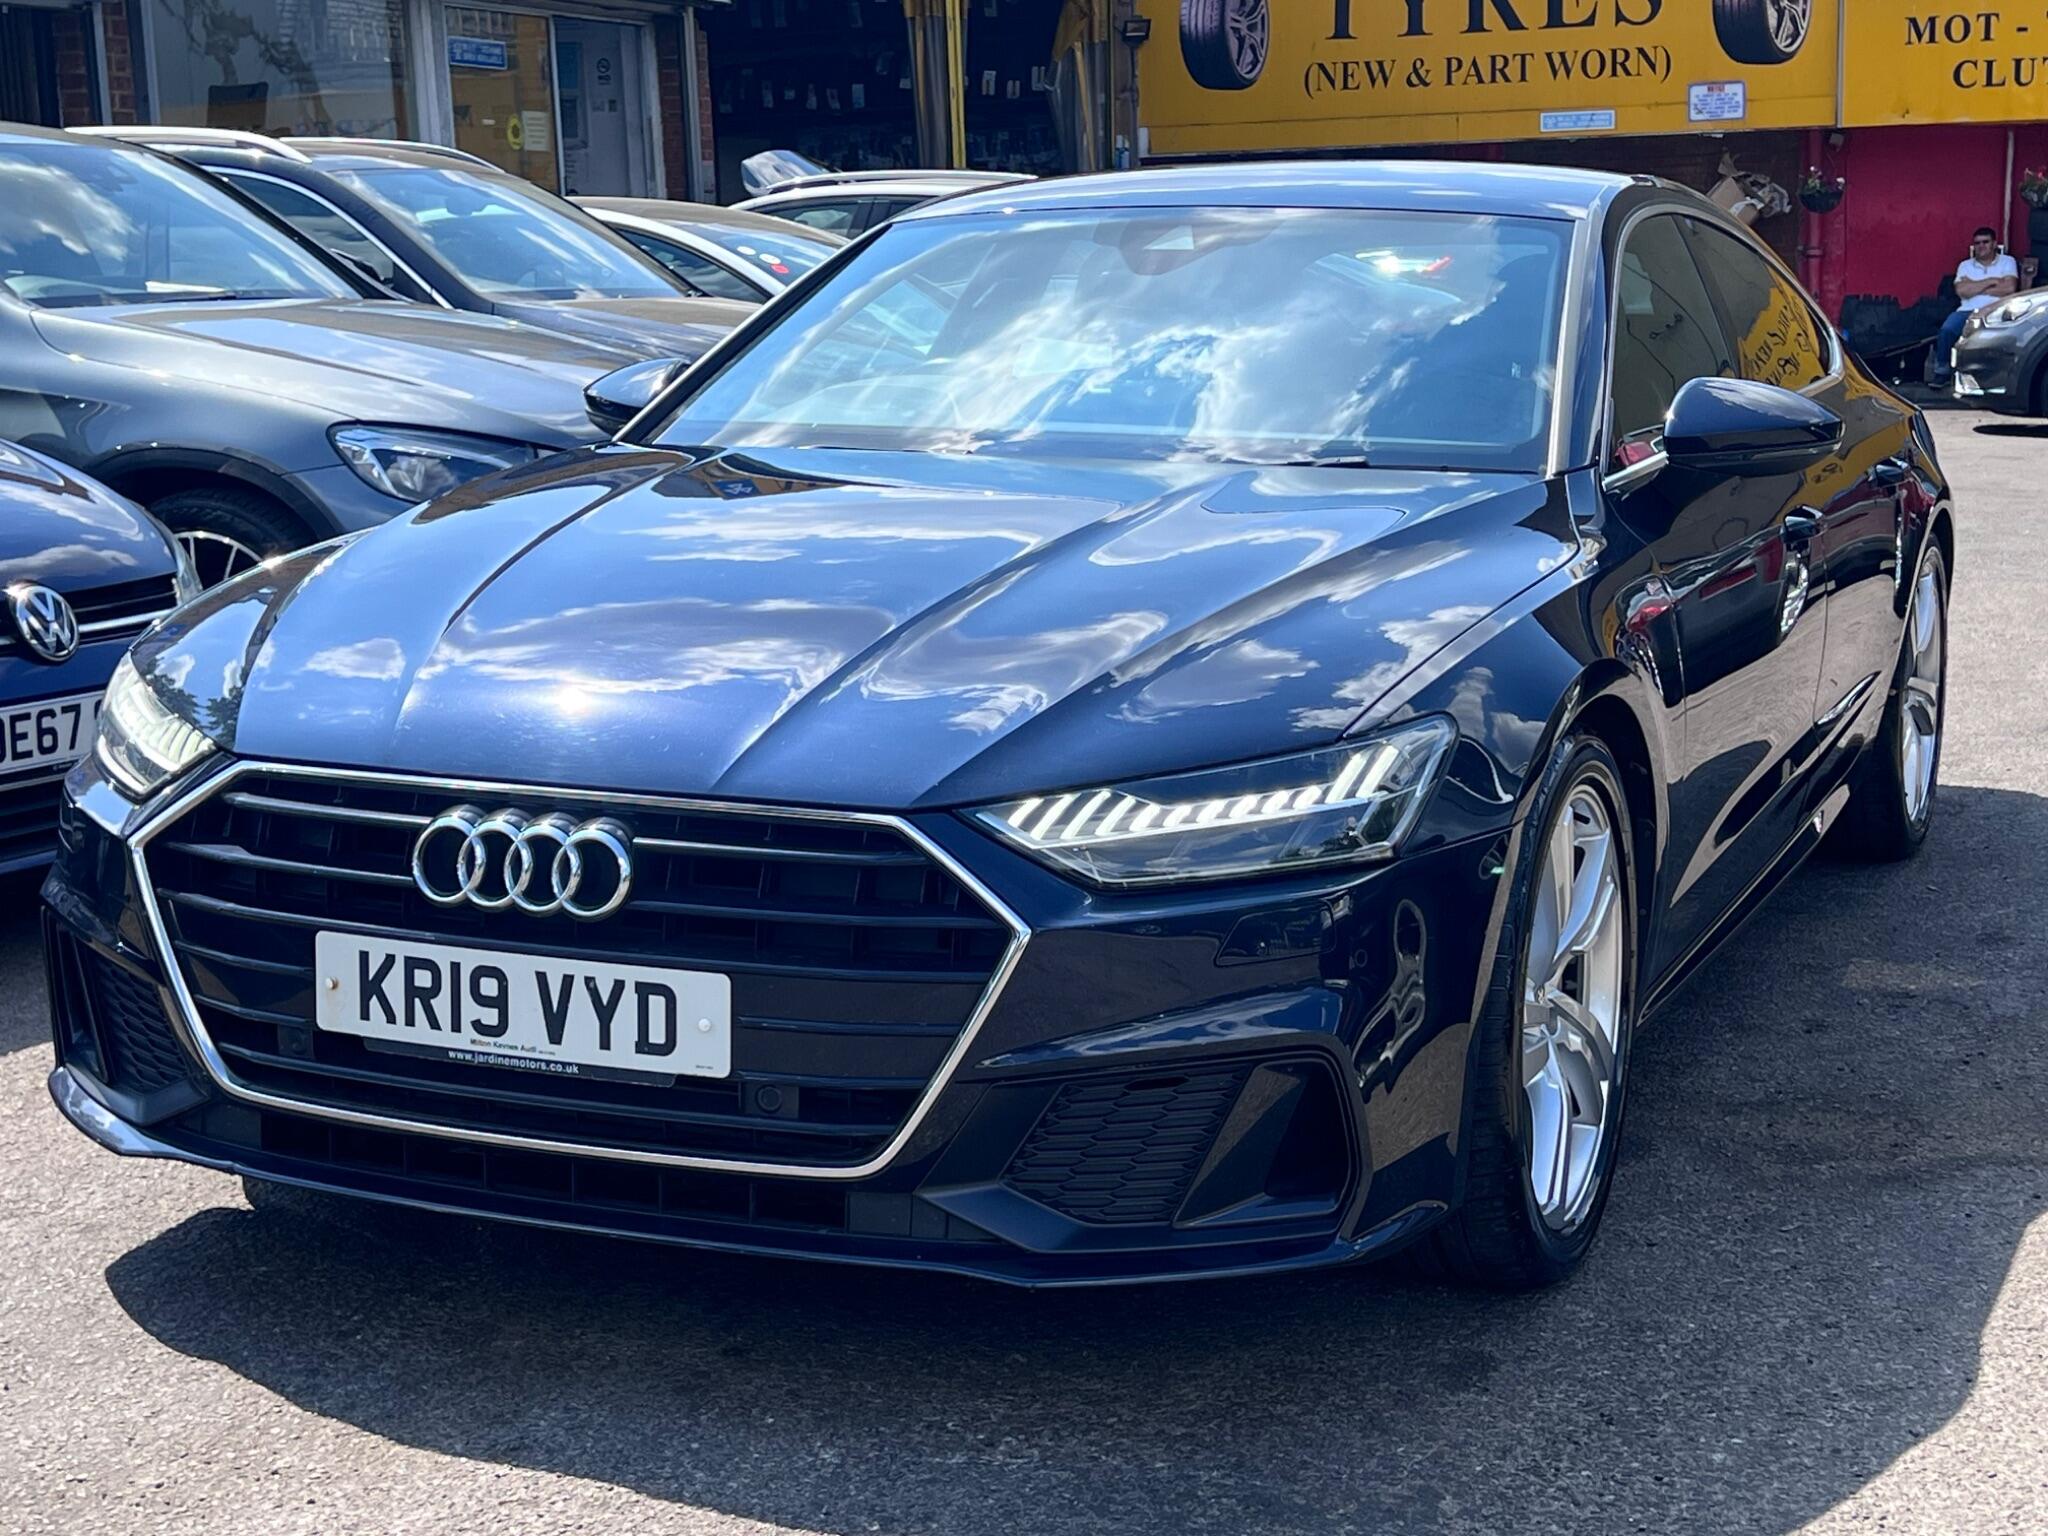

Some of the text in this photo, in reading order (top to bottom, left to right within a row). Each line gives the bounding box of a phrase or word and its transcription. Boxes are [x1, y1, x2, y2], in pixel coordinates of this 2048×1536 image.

[1905, 13, 2000, 45] MOT
[1304, 45, 1672, 99] (NEW & PART WORN)
[1953, 56, 2048, 89] CLU
[0, 703, 81, 763] E67
[358, 950, 677, 1057] KR19 VYD
[448, 1049, 579, 1074] www.jardinemotors.co.uk
